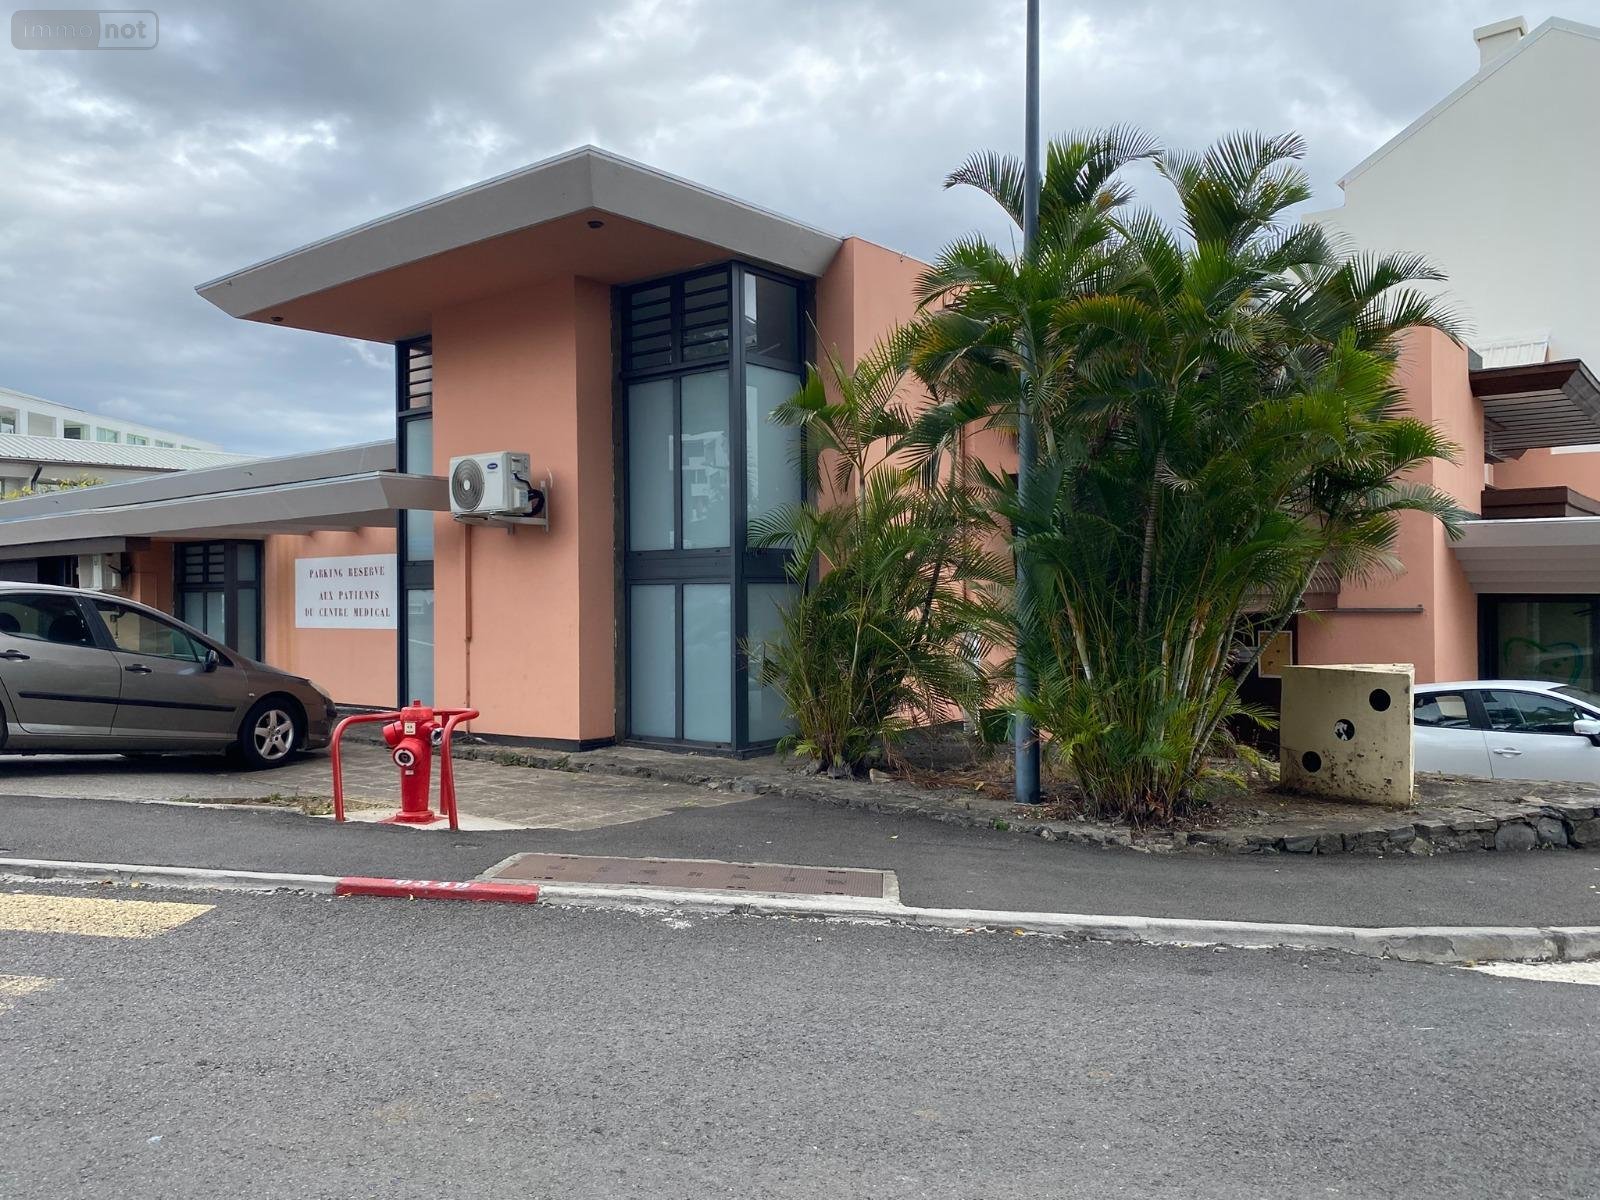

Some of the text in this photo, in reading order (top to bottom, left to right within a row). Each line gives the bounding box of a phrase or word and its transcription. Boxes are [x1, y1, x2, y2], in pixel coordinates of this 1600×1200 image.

[309, 566, 384, 578] PARKING RESERVE
[319, 590, 380, 600] AUX PATIENTS
[319, 607, 349, 617] CENTRE
[353, 607, 391, 617] MEDICAL
